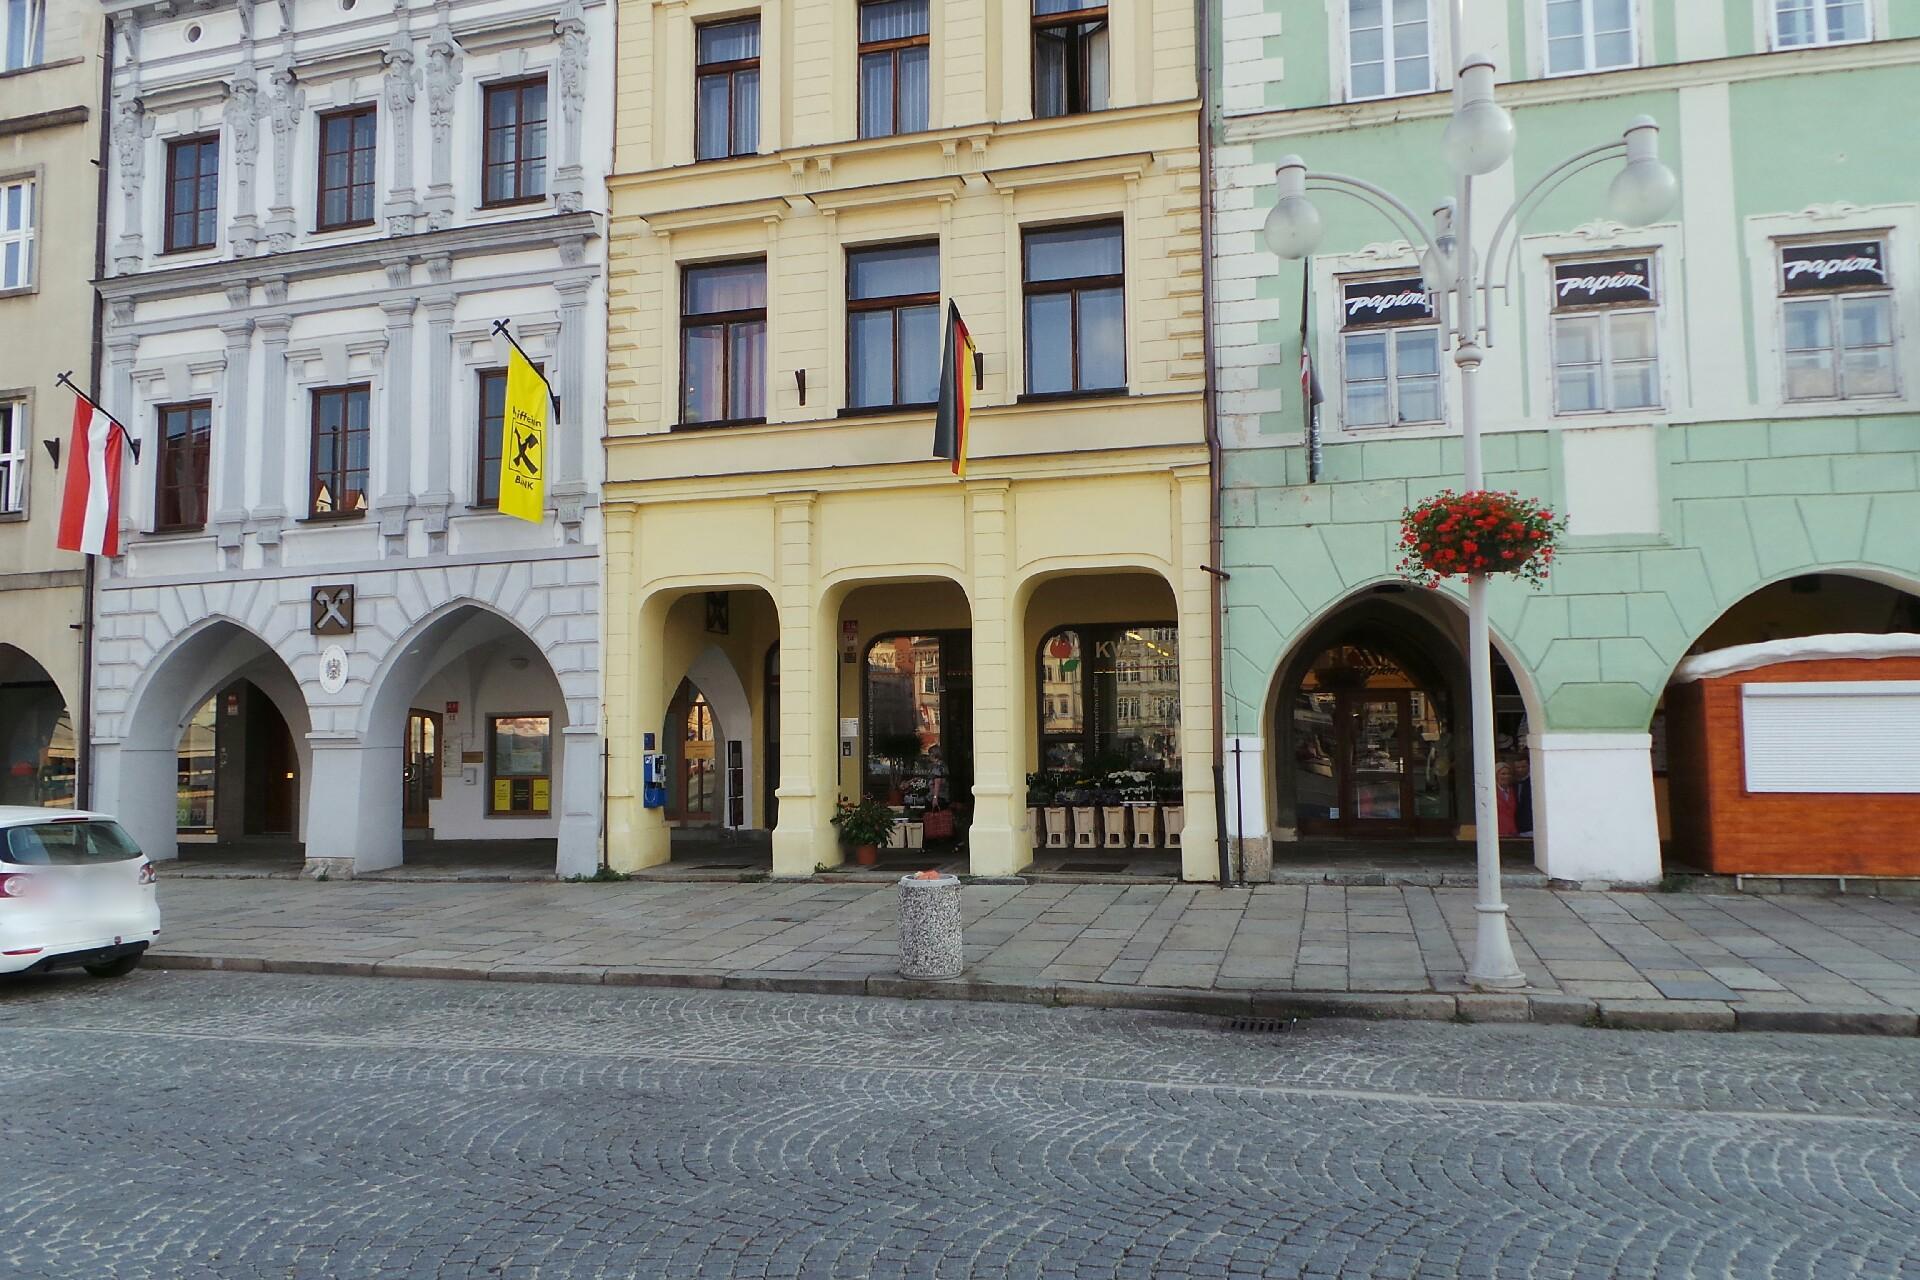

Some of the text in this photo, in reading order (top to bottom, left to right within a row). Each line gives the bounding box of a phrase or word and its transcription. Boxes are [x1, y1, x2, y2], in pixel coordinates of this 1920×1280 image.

[1784, 255, 1883, 280] papion
[1555, 271, 1650, 297] papion
[1345, 289, 1434, 316] papion
